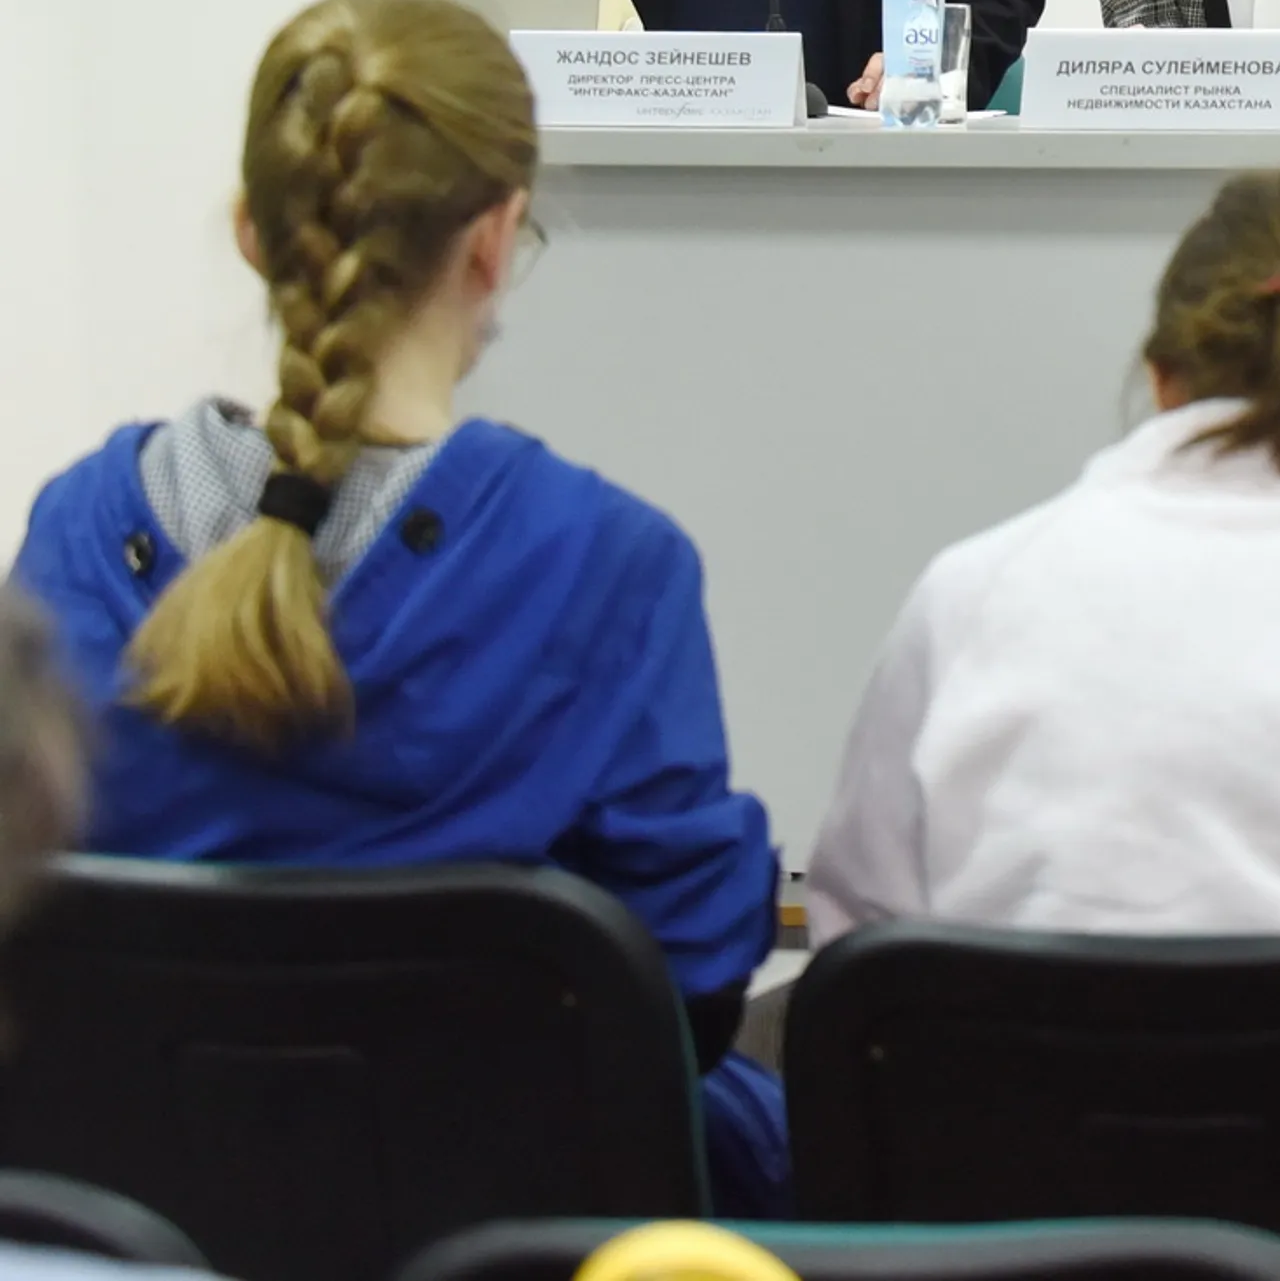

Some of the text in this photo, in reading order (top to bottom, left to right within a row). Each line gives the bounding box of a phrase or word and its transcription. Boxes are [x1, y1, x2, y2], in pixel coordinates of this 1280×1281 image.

[905, 27, 939, 44] asu
[556, 49, 751, 67] ЖАНДОС ЗЕЙНЕШЕВ
[1057, 60, 1135, 76] ДИЛЯРА
[568, 75, 736, 86] ДИРЕКТОР ПРЕСС-ЦЕНТРА
[568, 87, 734, 99] "ИНТЕРФАКС-КАЗАХСТАН"
[1100, 85, 1241, 97] СПЕЦИАЛИСТ РЫНКА
[1067, 99, 1272, 110] НЕДВИЖИМОСТИ КАЗАХСТАНА
